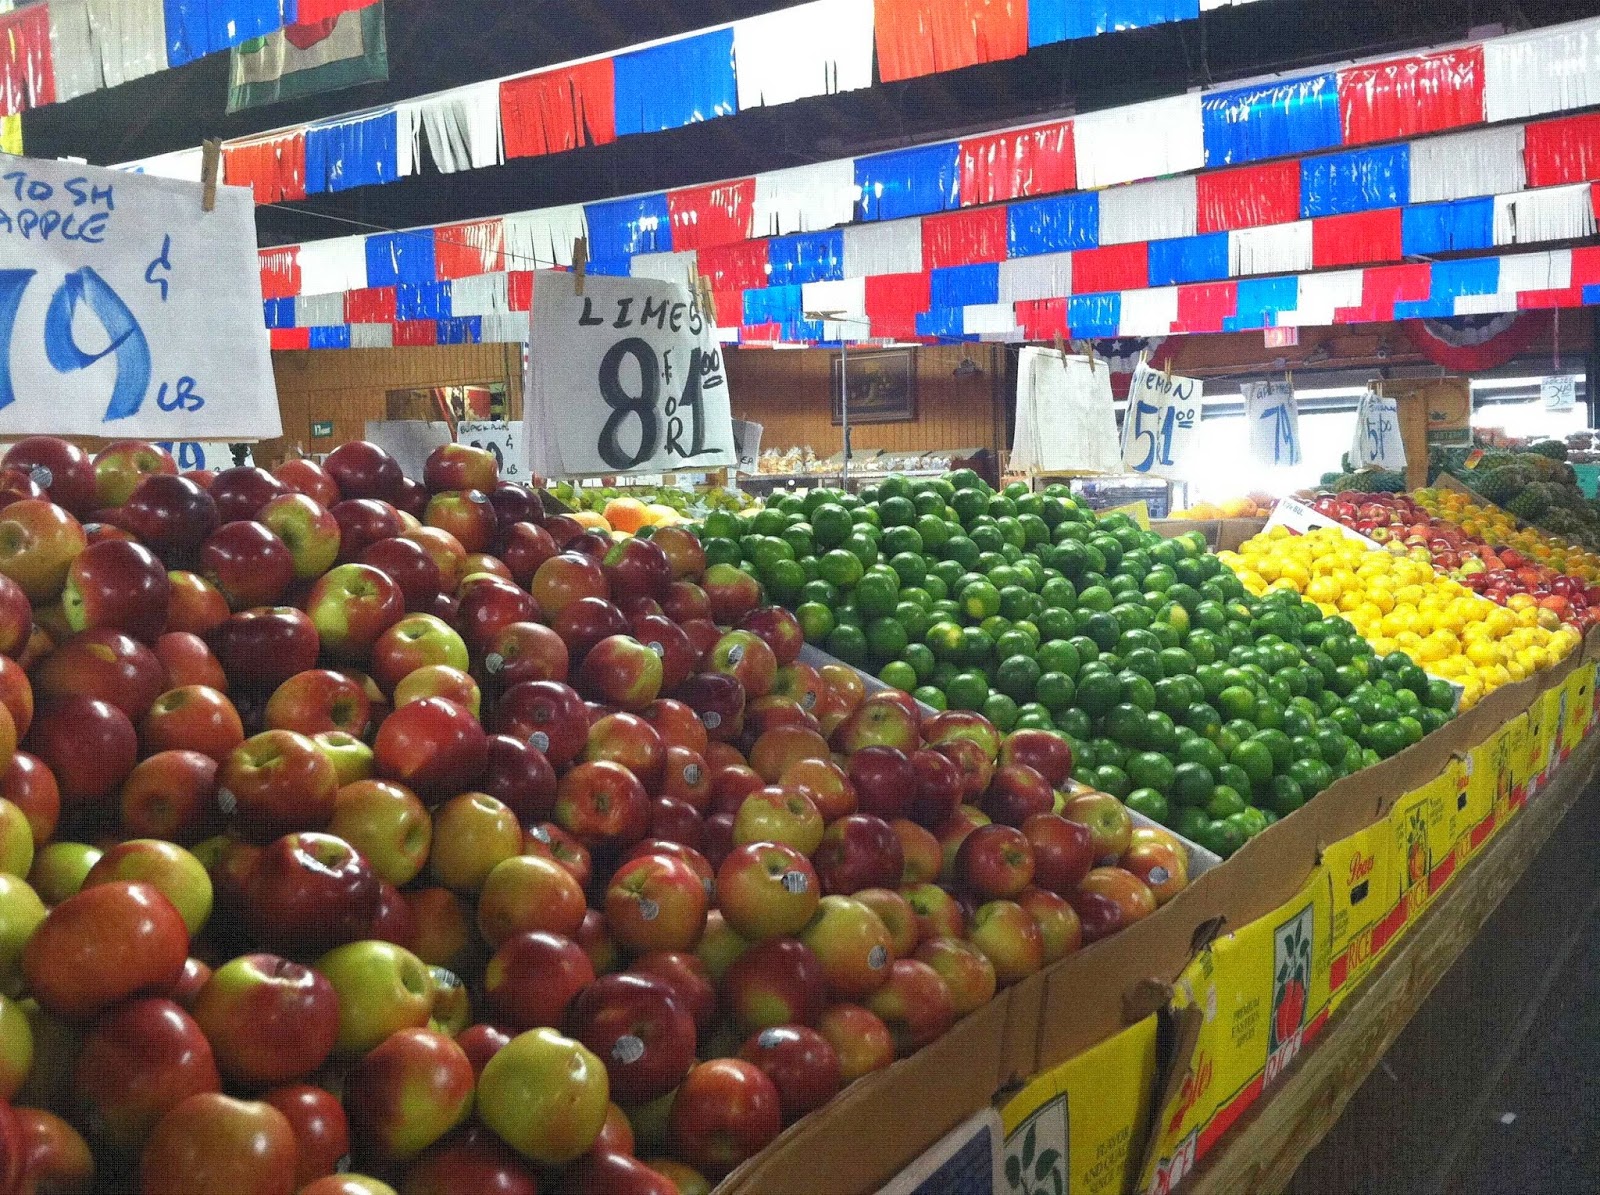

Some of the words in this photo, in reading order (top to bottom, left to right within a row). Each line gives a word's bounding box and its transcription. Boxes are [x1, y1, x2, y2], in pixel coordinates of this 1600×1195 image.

[578, 295, 703, 336] LIMES
[156, 374, 206, 412] LB
[597, 337, 662, 471] 8
[1133, 400, 1159, 473] 5
[1347, 926, 1372, 970] RICE
